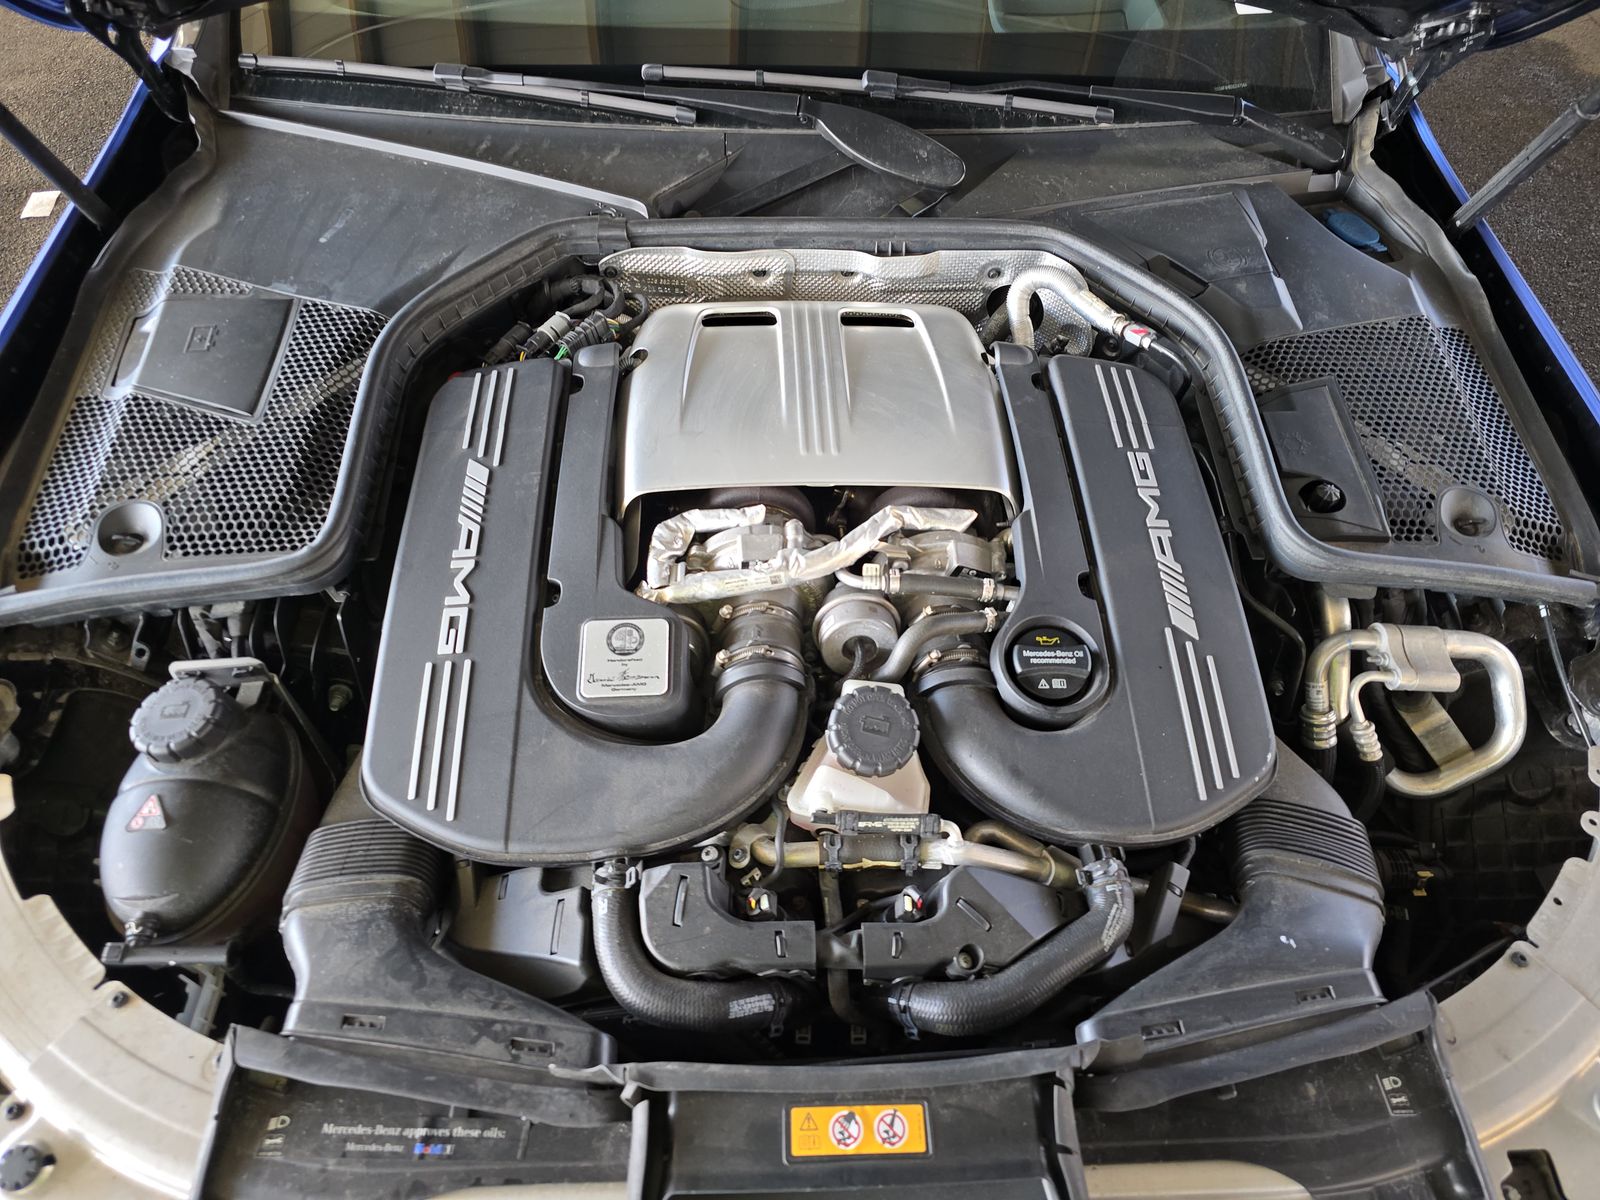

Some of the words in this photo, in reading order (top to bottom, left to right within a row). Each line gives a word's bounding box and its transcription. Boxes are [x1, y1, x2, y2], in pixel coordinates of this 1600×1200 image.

[1127, 451, 1183, 574] AMG
[437, 513, 481, 655] AMG
[1022, 649, 1073, 658] Mercedes-Benz
[1073, 650, 1084, 658] Oil
[1030, 657, 1077, 665] recommended
[321, 1122, 401, 1136] Mercedes-Benz
[402, 1126, 449, 1139] approves
[452, 1126, 481, 1138] these
[345, 1141, 405, 1152] Mercedes-Benz
